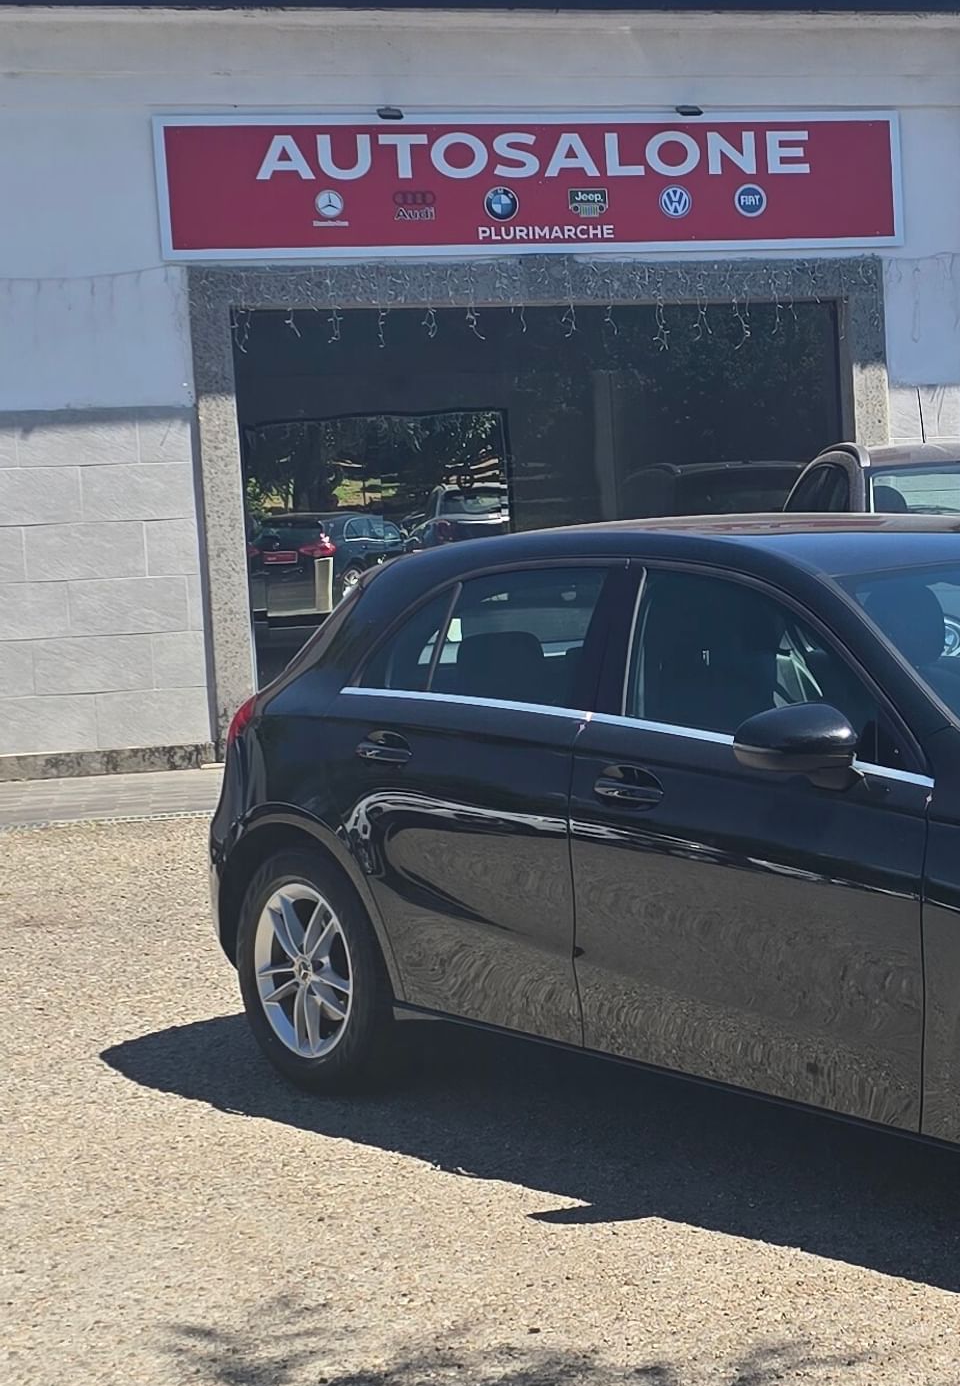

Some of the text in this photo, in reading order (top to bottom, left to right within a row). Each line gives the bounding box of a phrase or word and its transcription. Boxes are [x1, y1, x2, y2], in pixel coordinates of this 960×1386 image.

[256, 130, 811, 180] AUTOSALONE
[740, 195, 760, 206] FIAT
[394, 206, 436, 221] Audi
[478, 224, 615, 241] PLURIMARCHE
